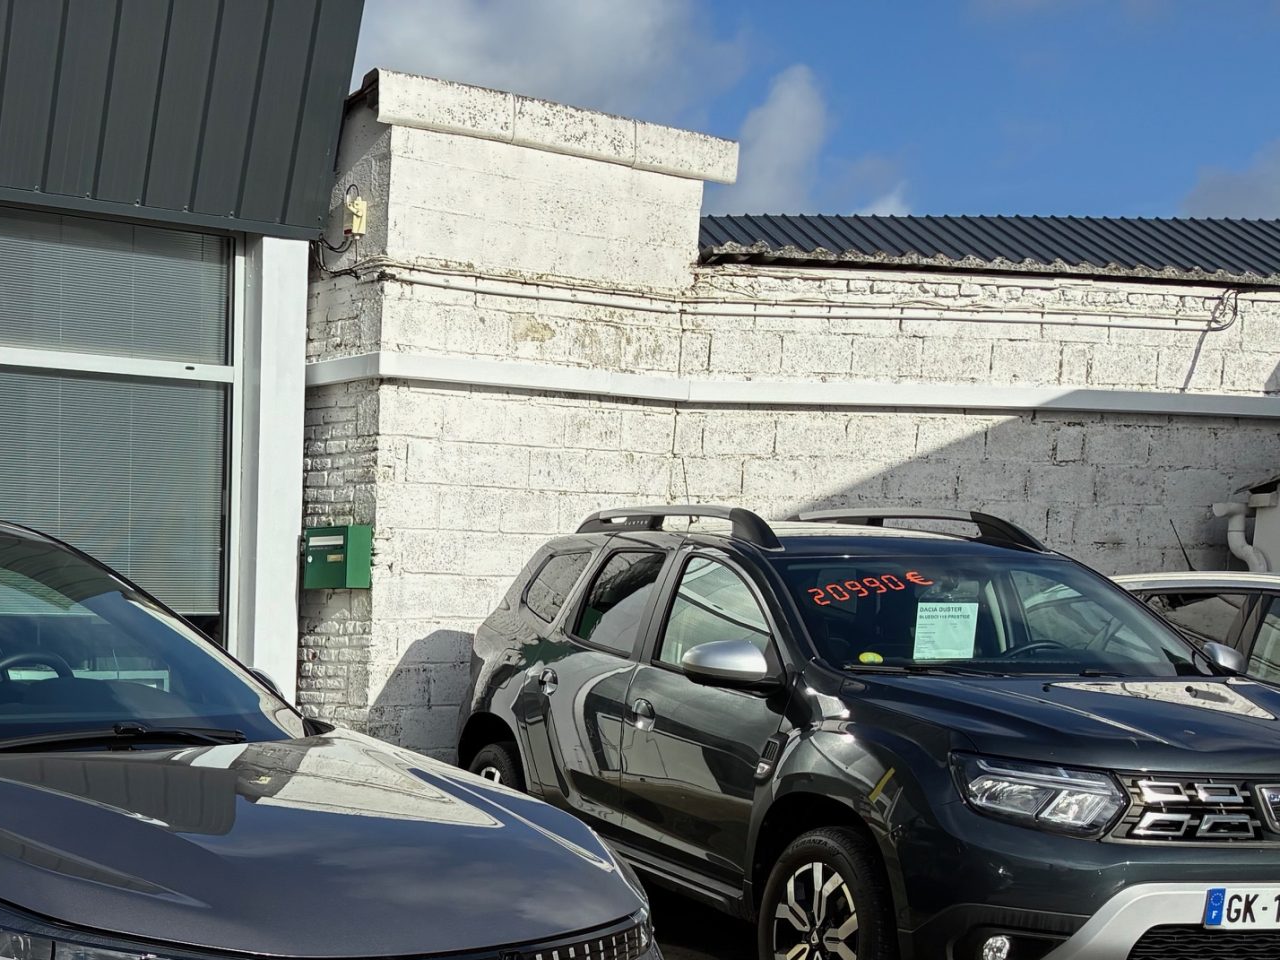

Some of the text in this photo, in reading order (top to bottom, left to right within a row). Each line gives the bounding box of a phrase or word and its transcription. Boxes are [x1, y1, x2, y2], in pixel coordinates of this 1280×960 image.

[808, 571, 934, 605] 20990 €
[1211, 911, 1218, 919] F
